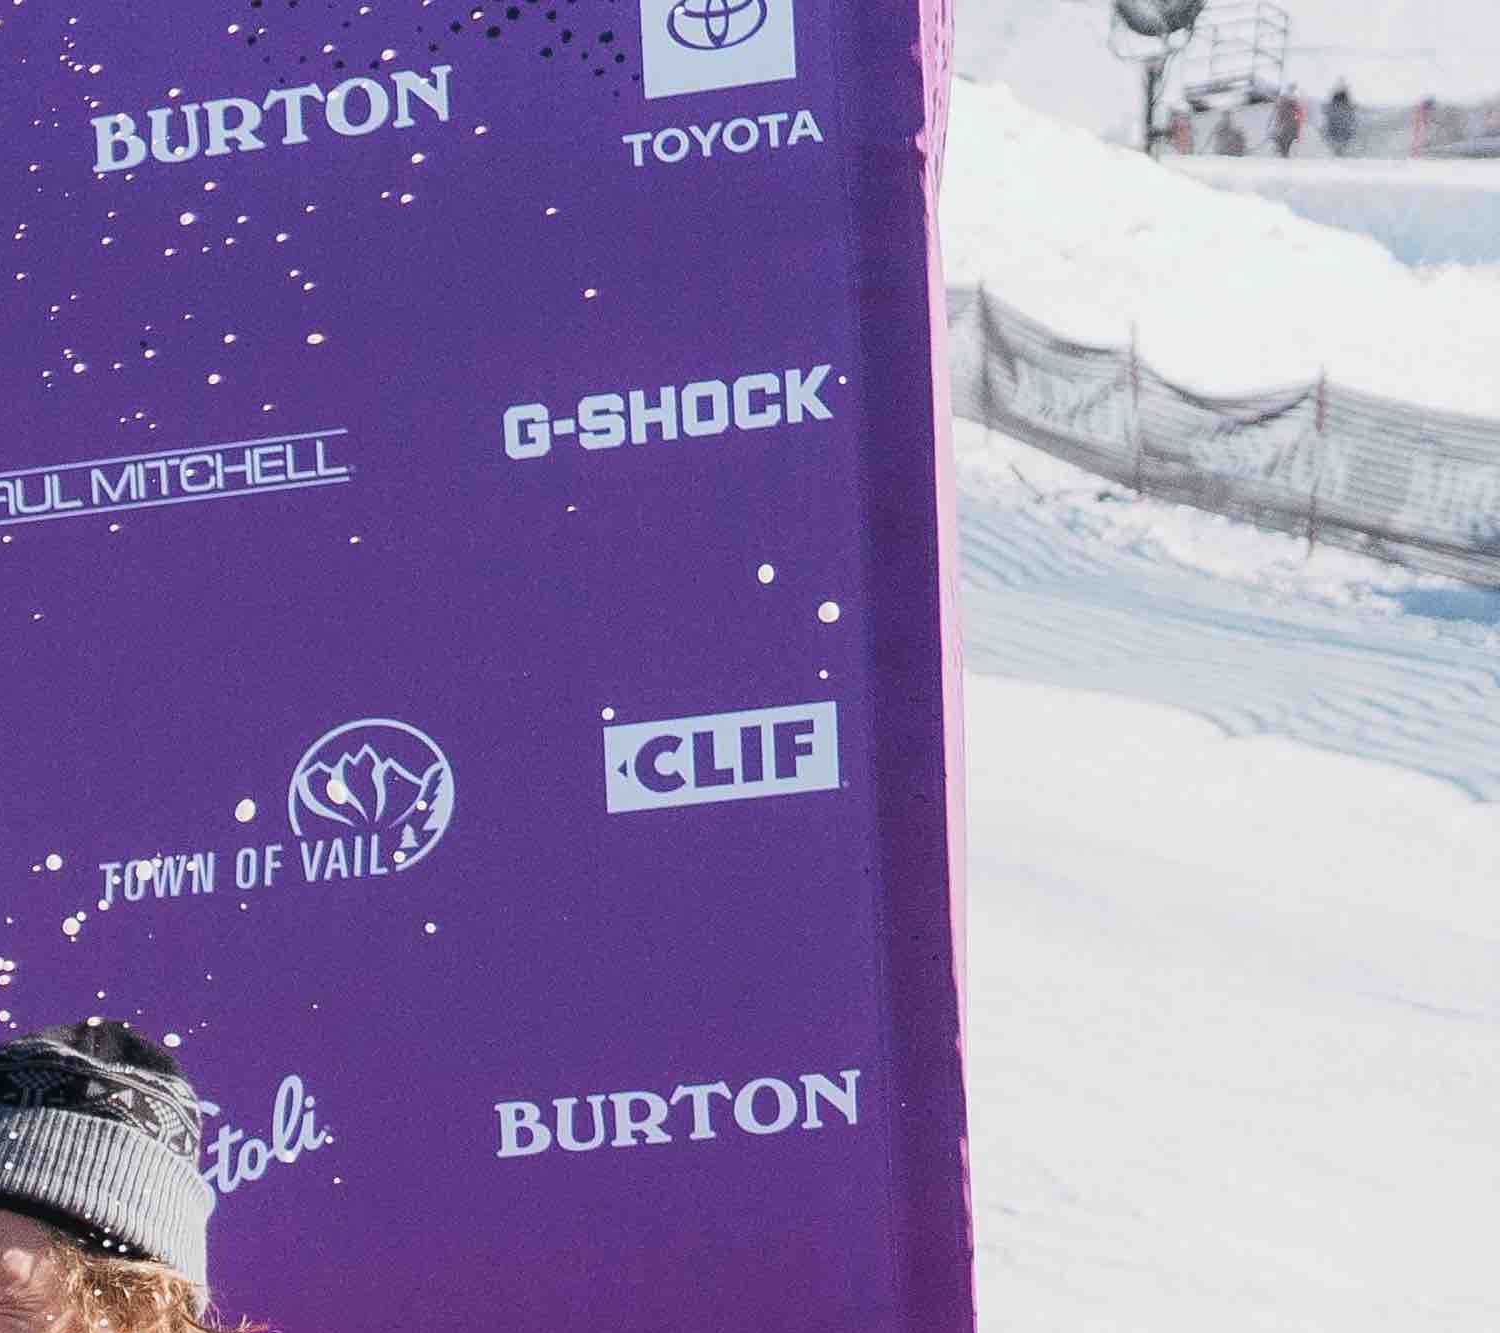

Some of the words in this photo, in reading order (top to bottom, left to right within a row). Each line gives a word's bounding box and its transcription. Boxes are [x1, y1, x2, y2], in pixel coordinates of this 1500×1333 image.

[90, 64, 453, 173] BURTON
[622, 109, 824, 167] TOYOTA
[503, 364, 834, 460] G-SHOCK
[91, 438, 350, 505] MITCHELL
[634, 718, 815, 793] CLIF
[97, 851, 215, 911] TOWN
[235, 843, 283, 890] OF
[300, 833, 389, 882] VAIL
[494, 1069, 861, 1158] BURTON
